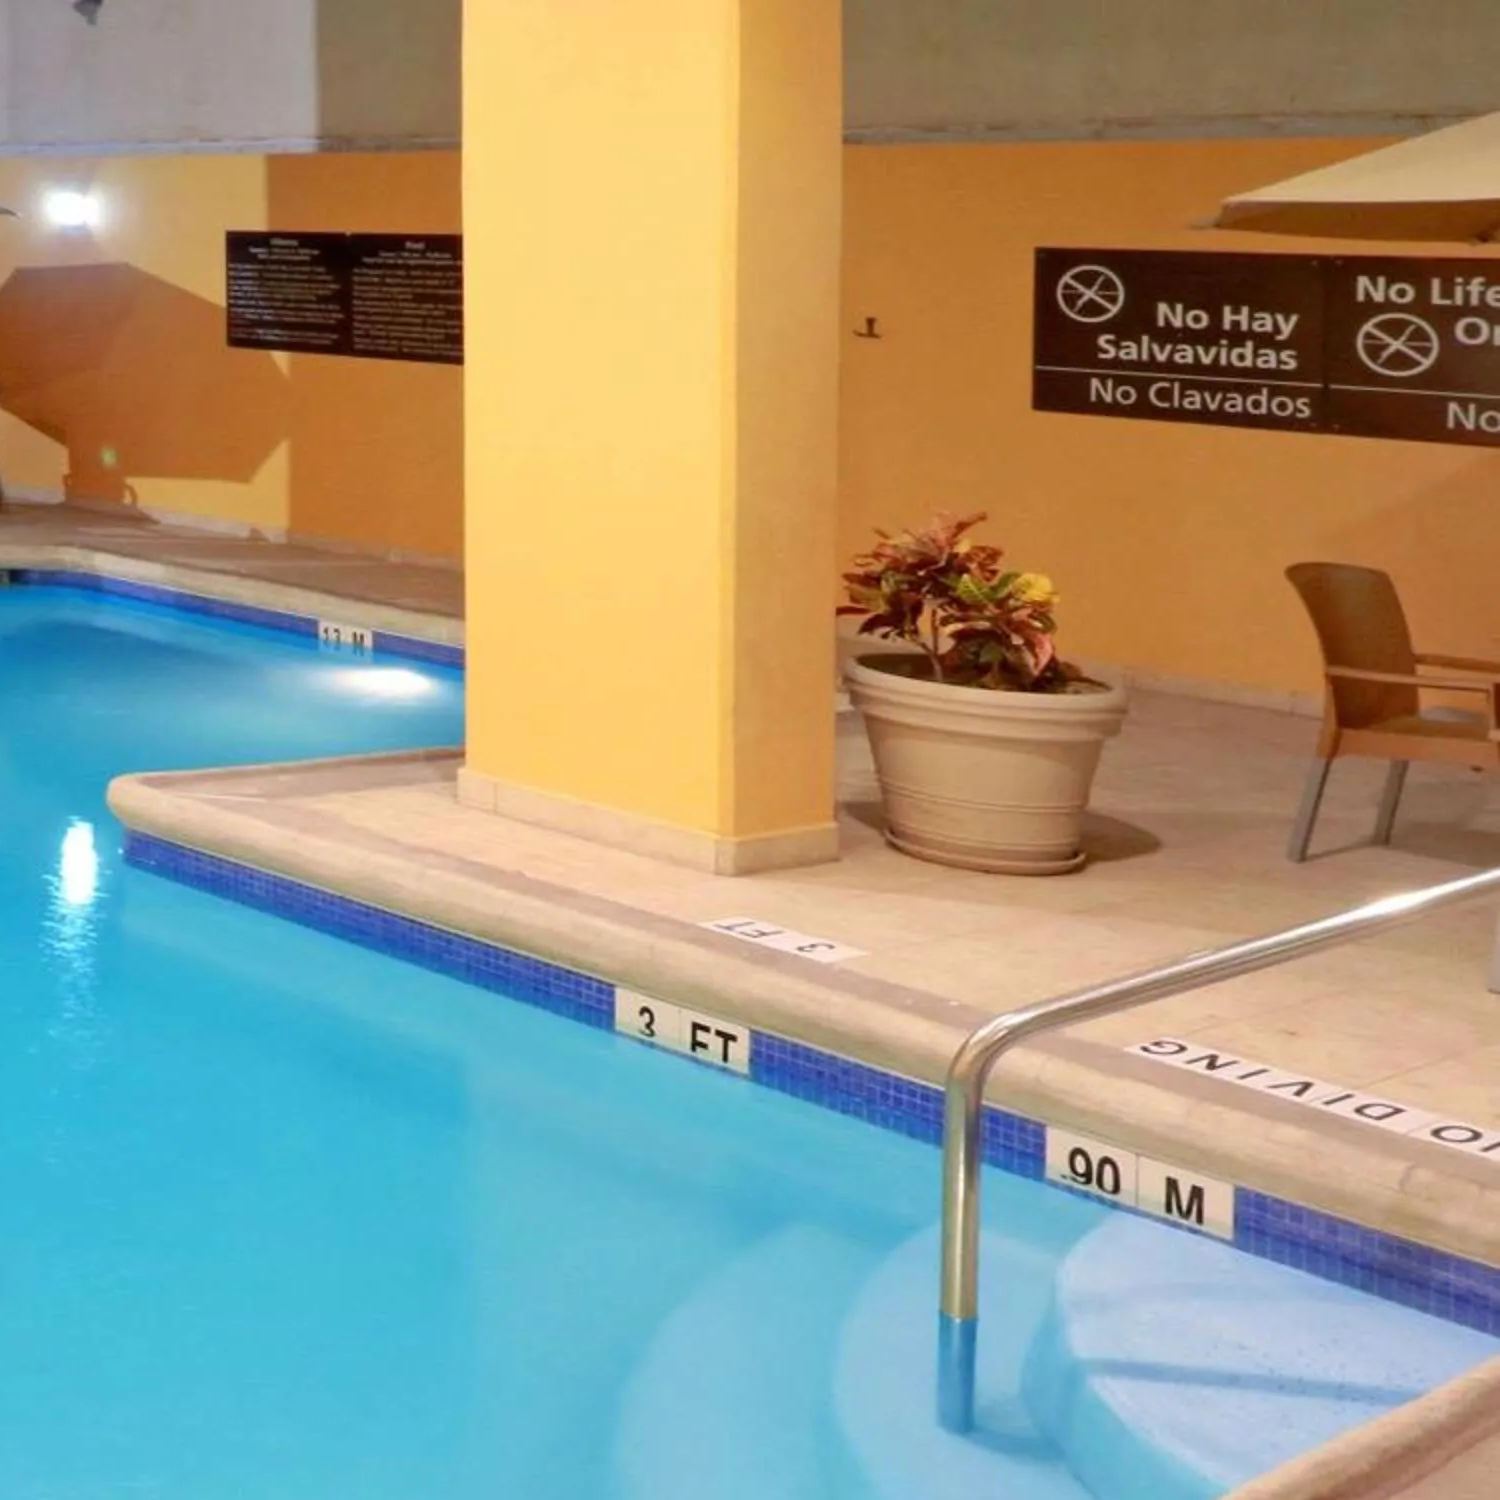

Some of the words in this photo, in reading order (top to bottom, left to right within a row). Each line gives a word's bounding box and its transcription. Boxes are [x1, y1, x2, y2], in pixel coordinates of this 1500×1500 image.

[1356, 275, 1416, 304] No
[1156, 302, 1208, 331] No
[1222, 305, 1299, 340] Hay
[1097, 334, 1298, 371] Salvavidas
[1089, 377, 1137, 406] No
[1149, 381, 1312, 418] Clavados
[1447, 401, 1500, 433] No
[638, 1005, 657, 1038] 3
[690, 1021, 738, 1063] FT
[1139, 1039, 1406, 1121] DIVING
[1165, 1172, 1204, 1225] M
